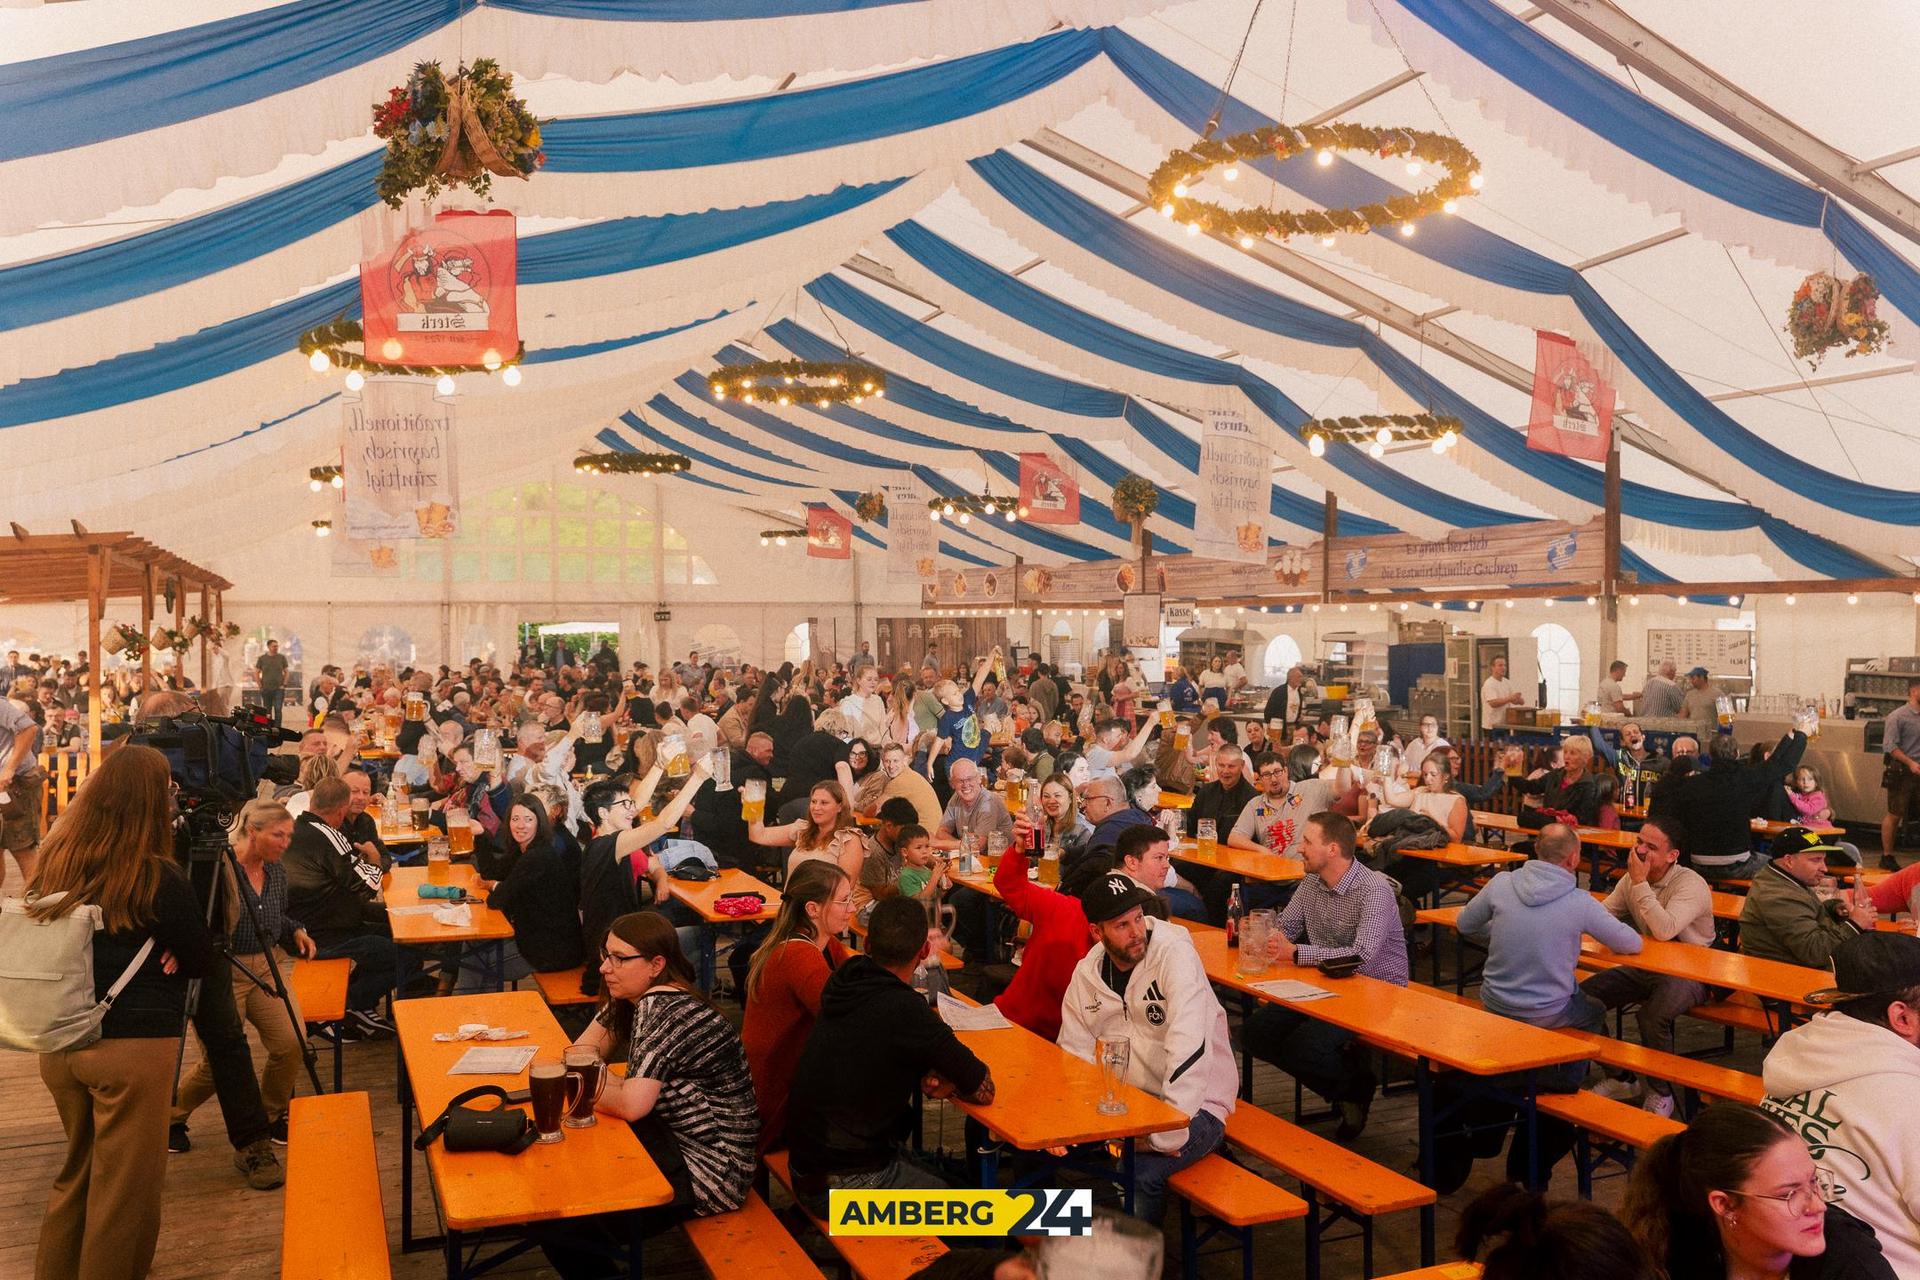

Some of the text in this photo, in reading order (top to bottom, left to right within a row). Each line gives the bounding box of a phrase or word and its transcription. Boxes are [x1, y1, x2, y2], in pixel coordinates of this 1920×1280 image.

[1381, 565, 1395, 580] die
[1169, 607, 1191, 617] Kasse
[1108, 877, 1128, 896] NY
[1148, 1012, 1163, 1021] FCN
